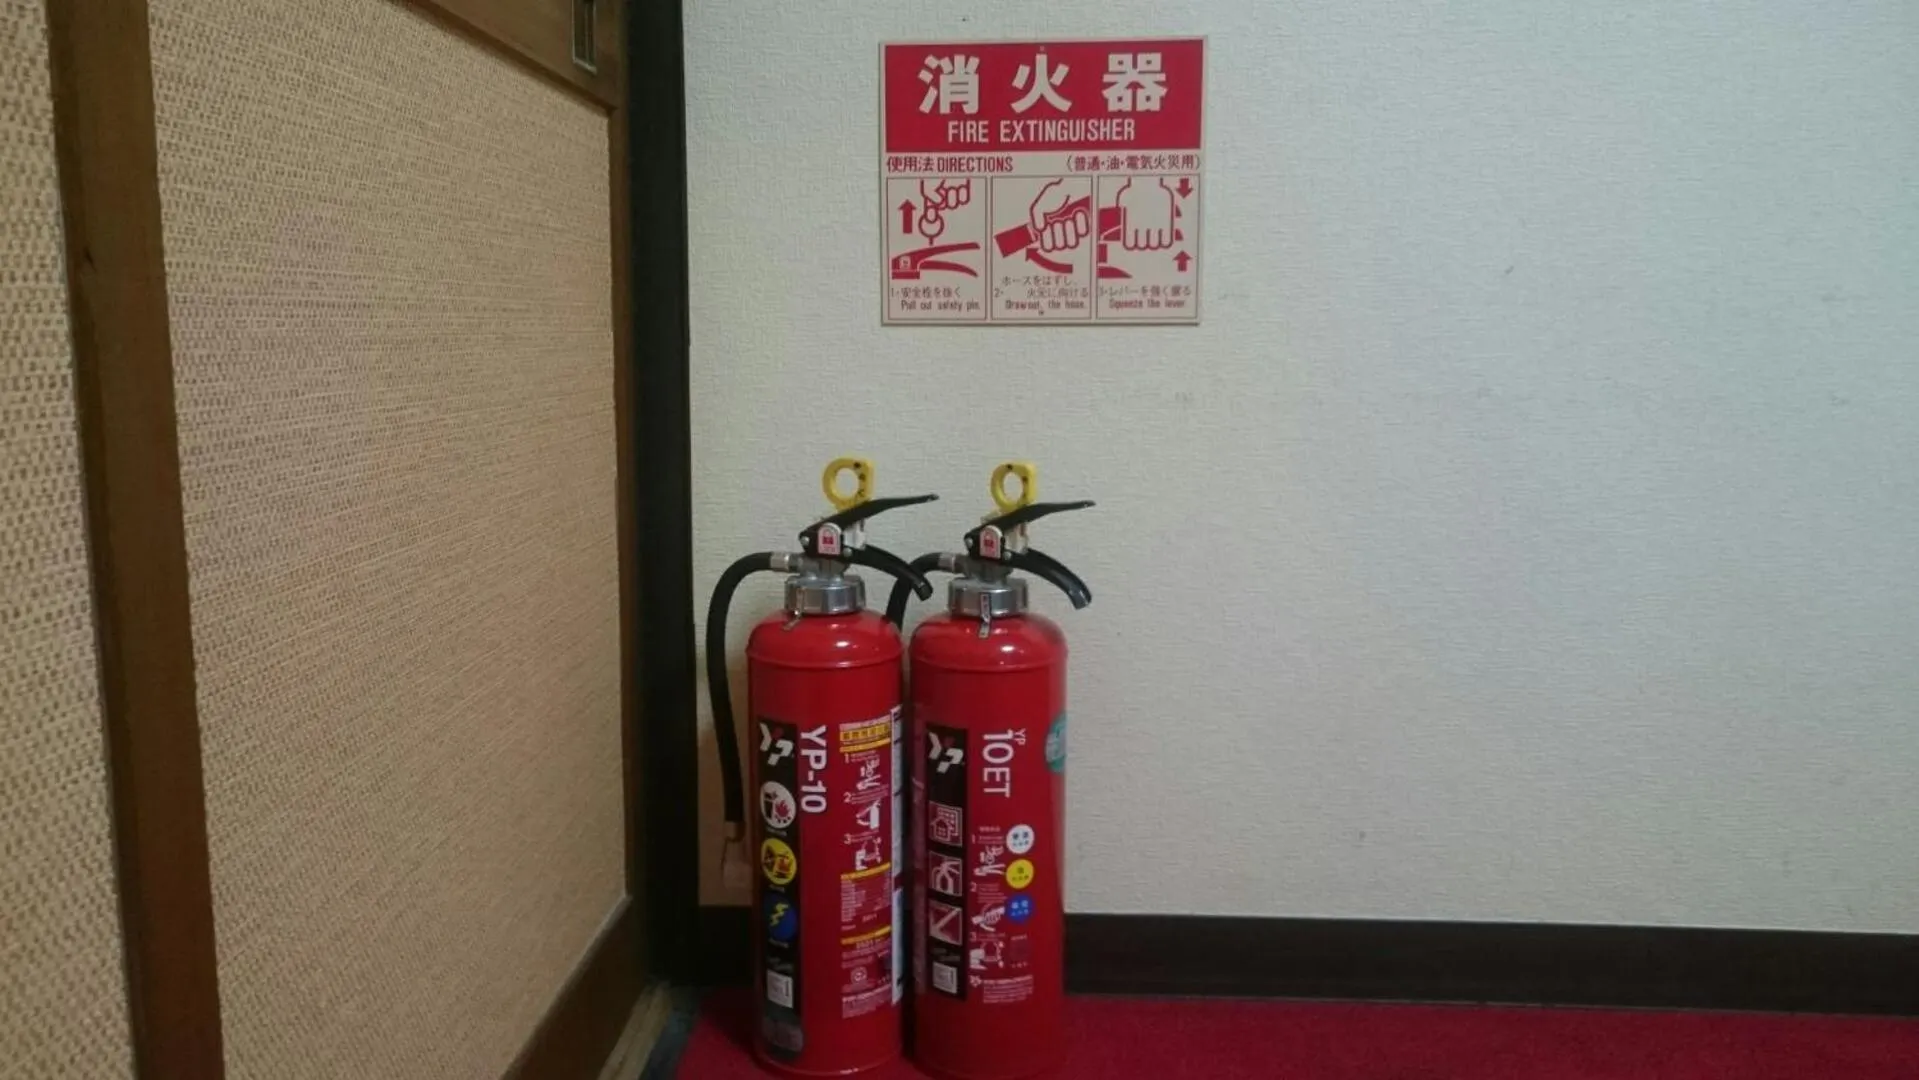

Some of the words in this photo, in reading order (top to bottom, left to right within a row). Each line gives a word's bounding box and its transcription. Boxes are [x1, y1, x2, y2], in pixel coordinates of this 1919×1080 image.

[918, 52, 1168, 114] 消火器
[948, 120, 989, 143] FIRE
[1000, 119, 1136, 142] EXTINGUISHER
[886, 156, 936, 173] 使用法
[937, 157, 1013, 172] DIRECTIONS
[801, 724, 827, 813] YP-10
[982, 728, 1015, 797] 10ET
